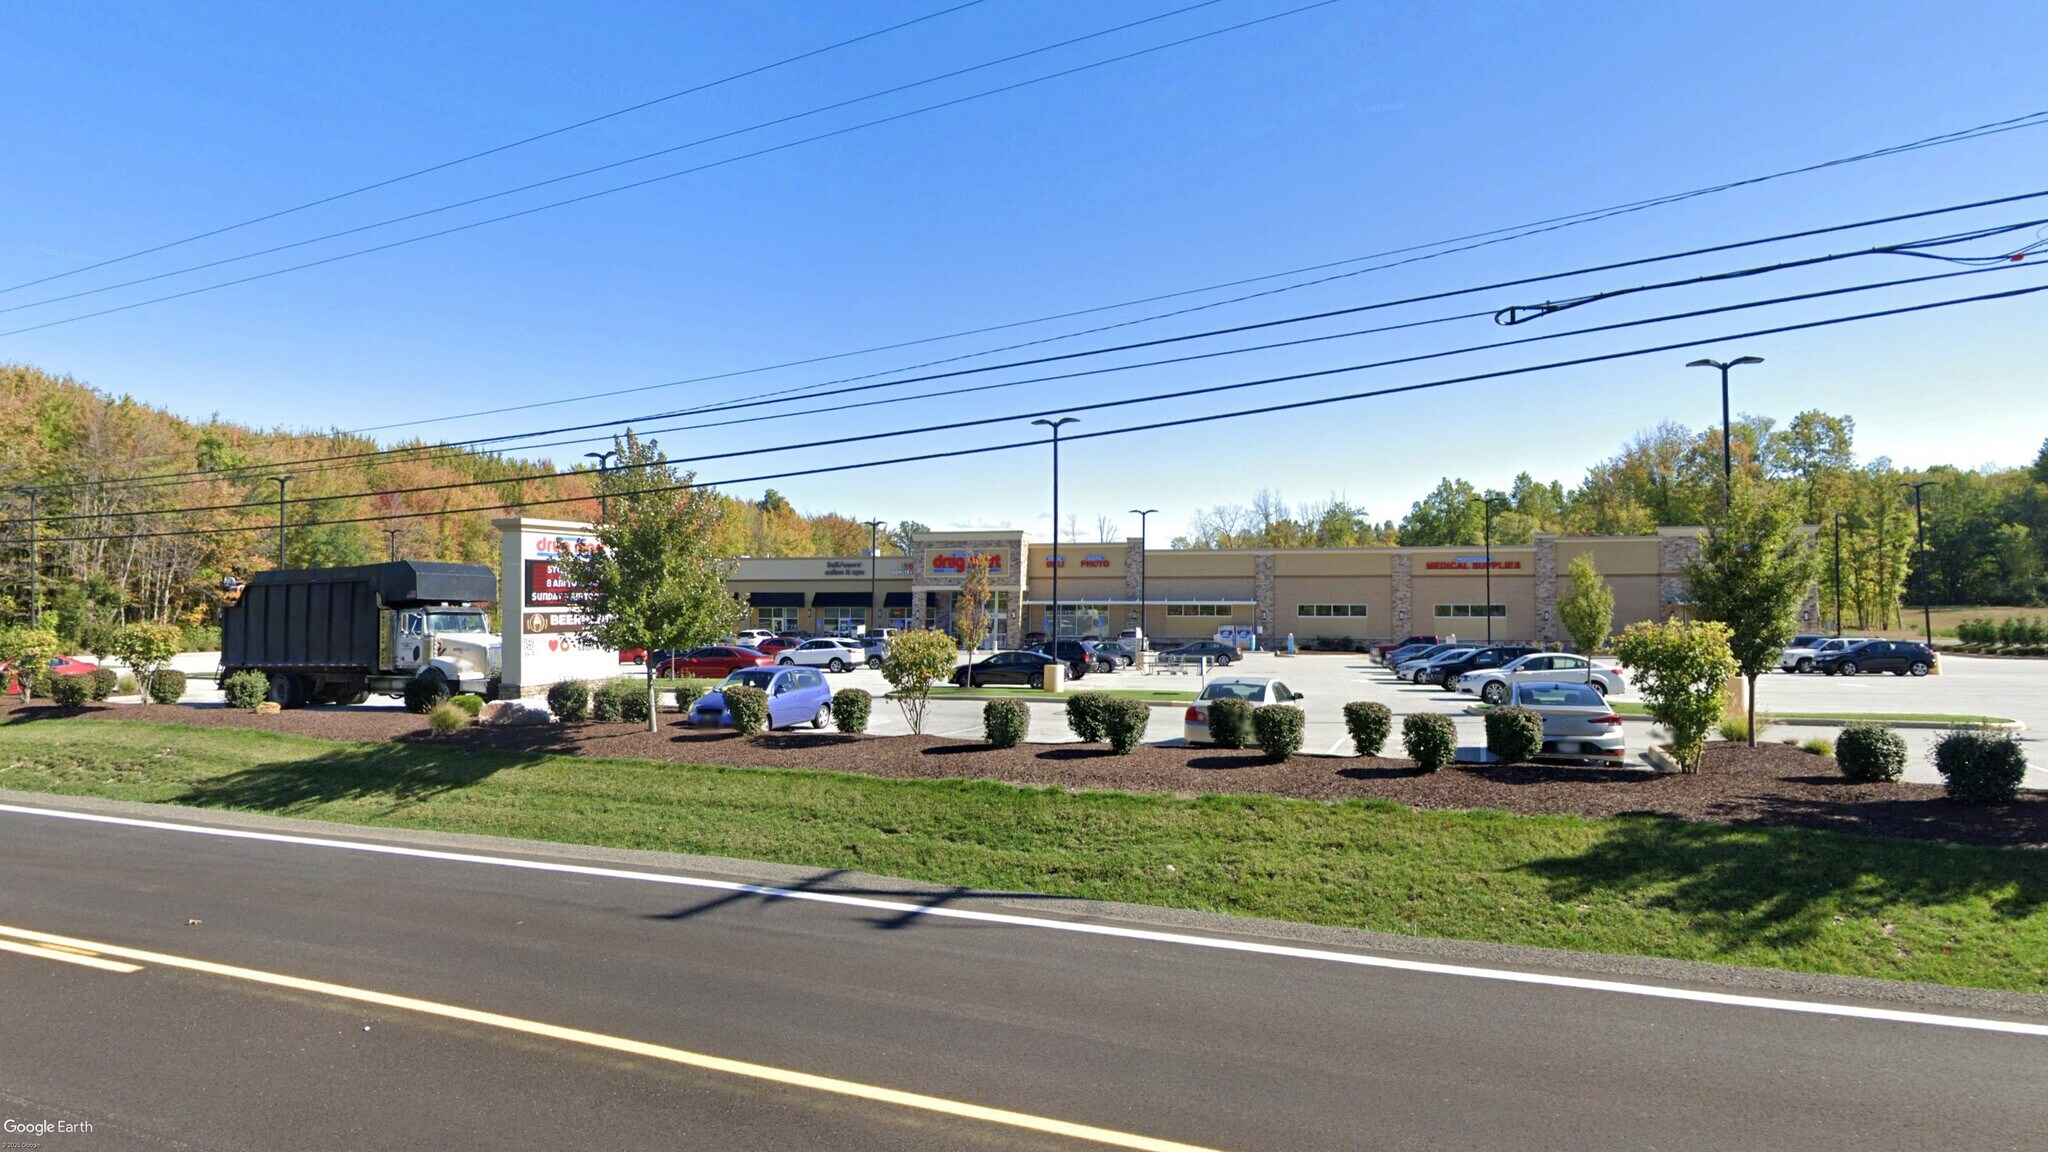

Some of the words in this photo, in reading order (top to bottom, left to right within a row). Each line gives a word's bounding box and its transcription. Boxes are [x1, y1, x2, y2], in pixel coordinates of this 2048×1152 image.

[932, 554, 965, 573] drug
[1080, 560, 1110, 568] PHOTO
[1426, 561, 1469, 570] MEDICAL
[531, 592, 562, 601] SUNDAY
